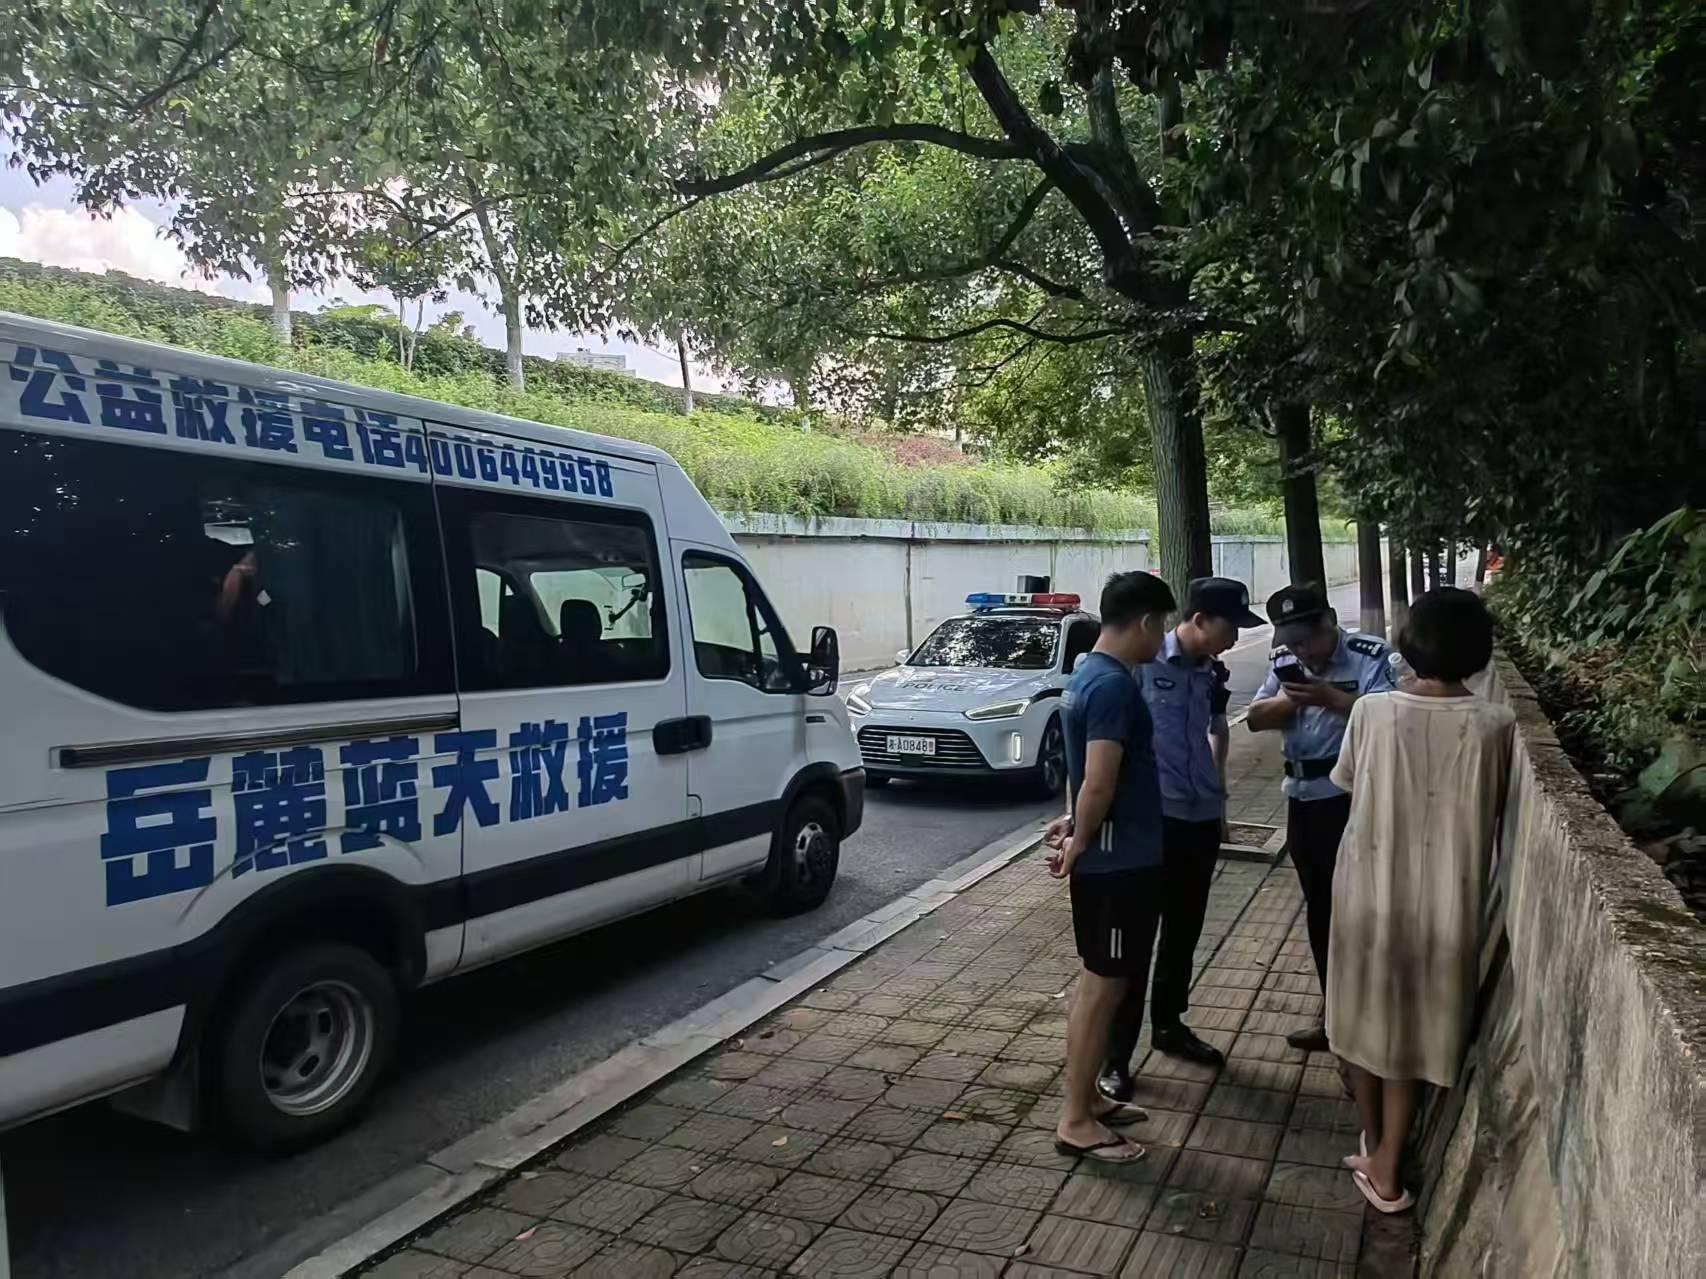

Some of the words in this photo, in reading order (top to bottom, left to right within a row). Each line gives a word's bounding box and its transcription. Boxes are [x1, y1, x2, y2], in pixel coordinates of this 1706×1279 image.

[9, 346, 614, 498] 公益救援电话4006449958
[902, 682, 966, 692] POLICE
[100, 712, 629, 907] 岳麓蓝天救援
